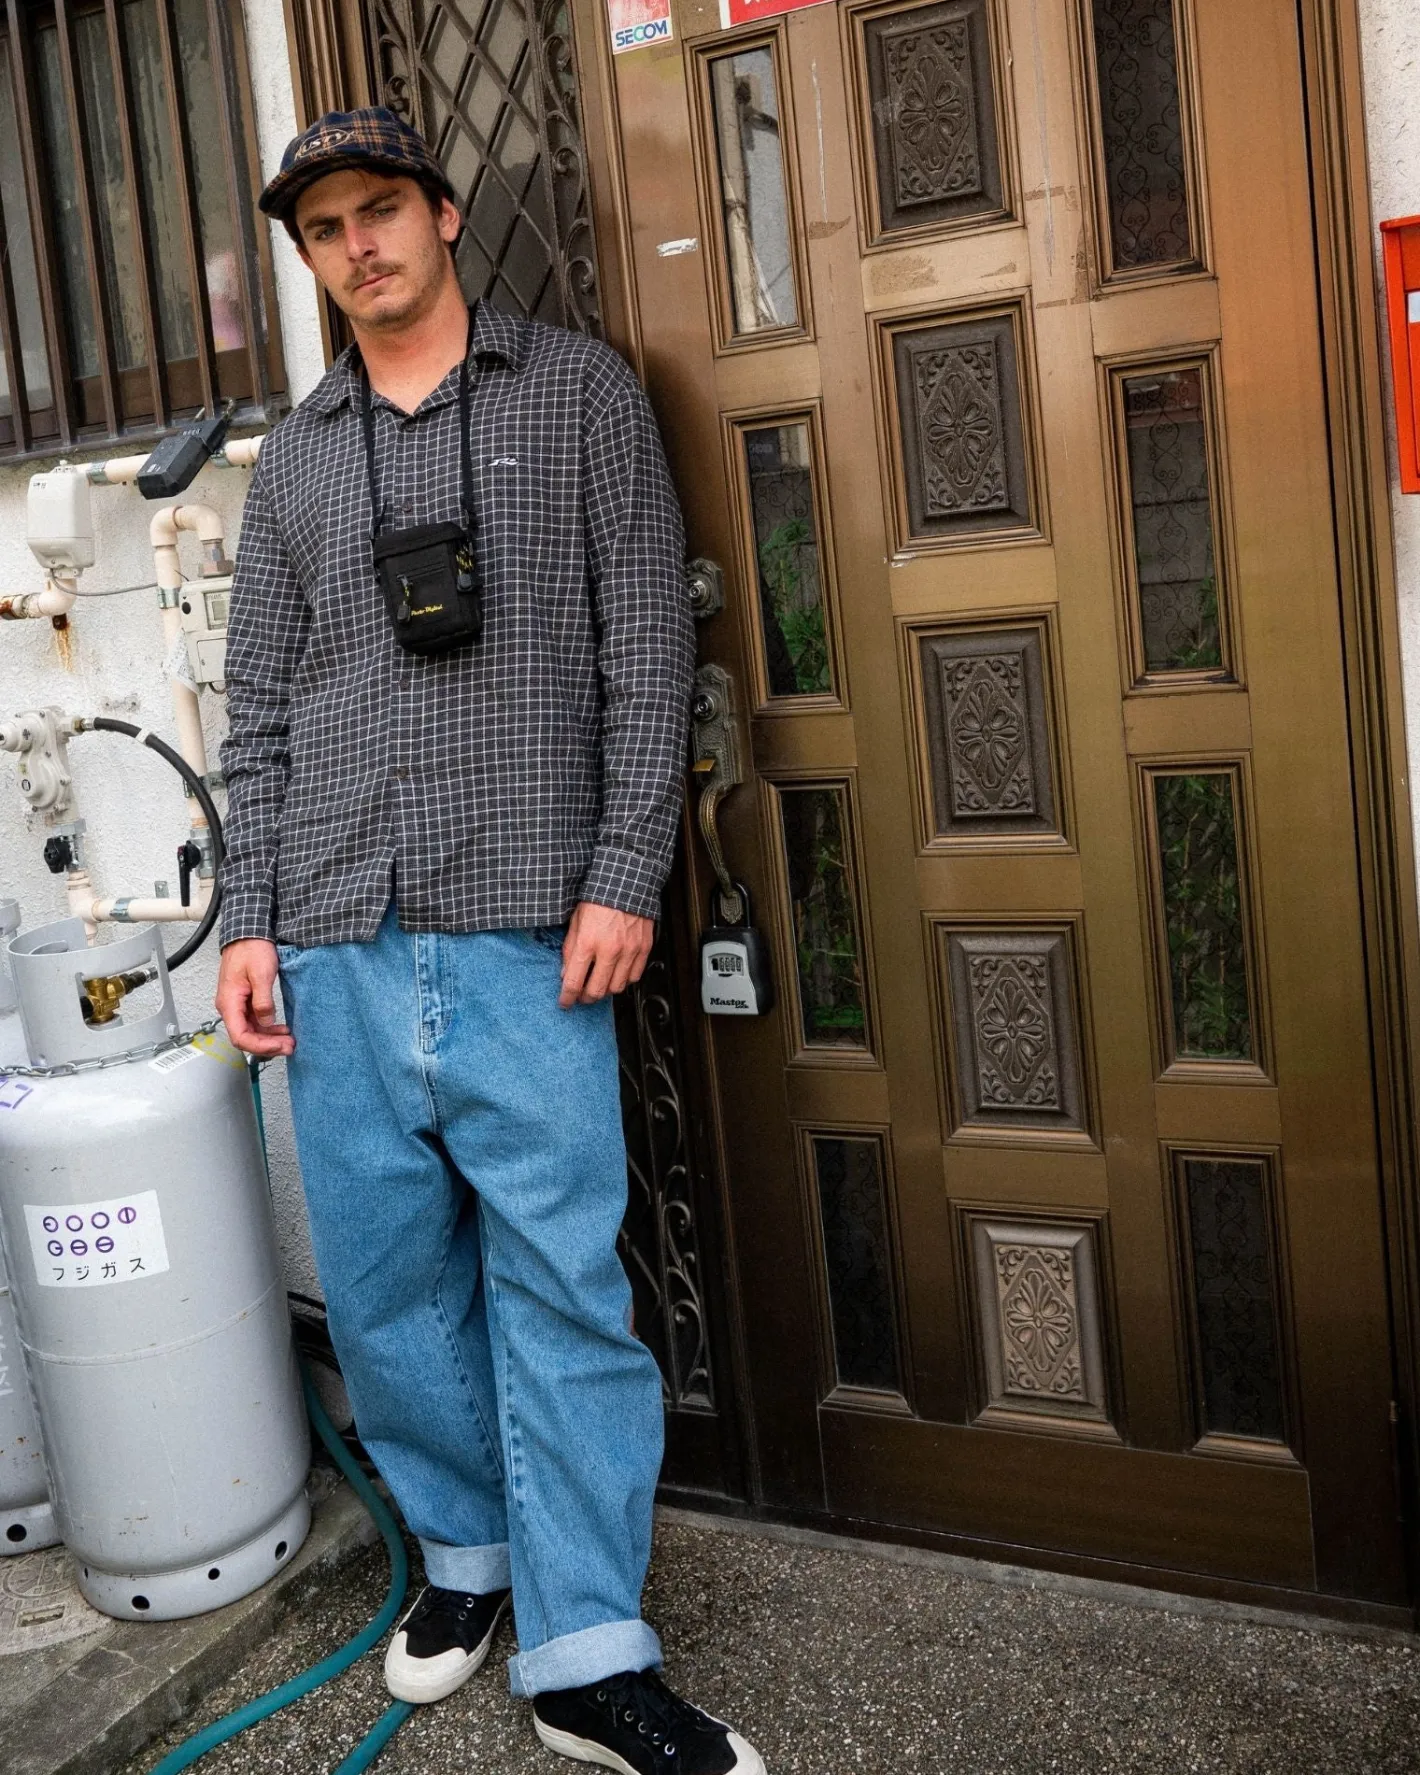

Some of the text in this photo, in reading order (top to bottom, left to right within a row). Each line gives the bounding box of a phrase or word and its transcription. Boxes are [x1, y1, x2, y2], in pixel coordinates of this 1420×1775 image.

[615, 20, 668, 47] SECOM
[710, 997, 746, 1006] Master
[52, 1257, 146, 1281] フジガス
